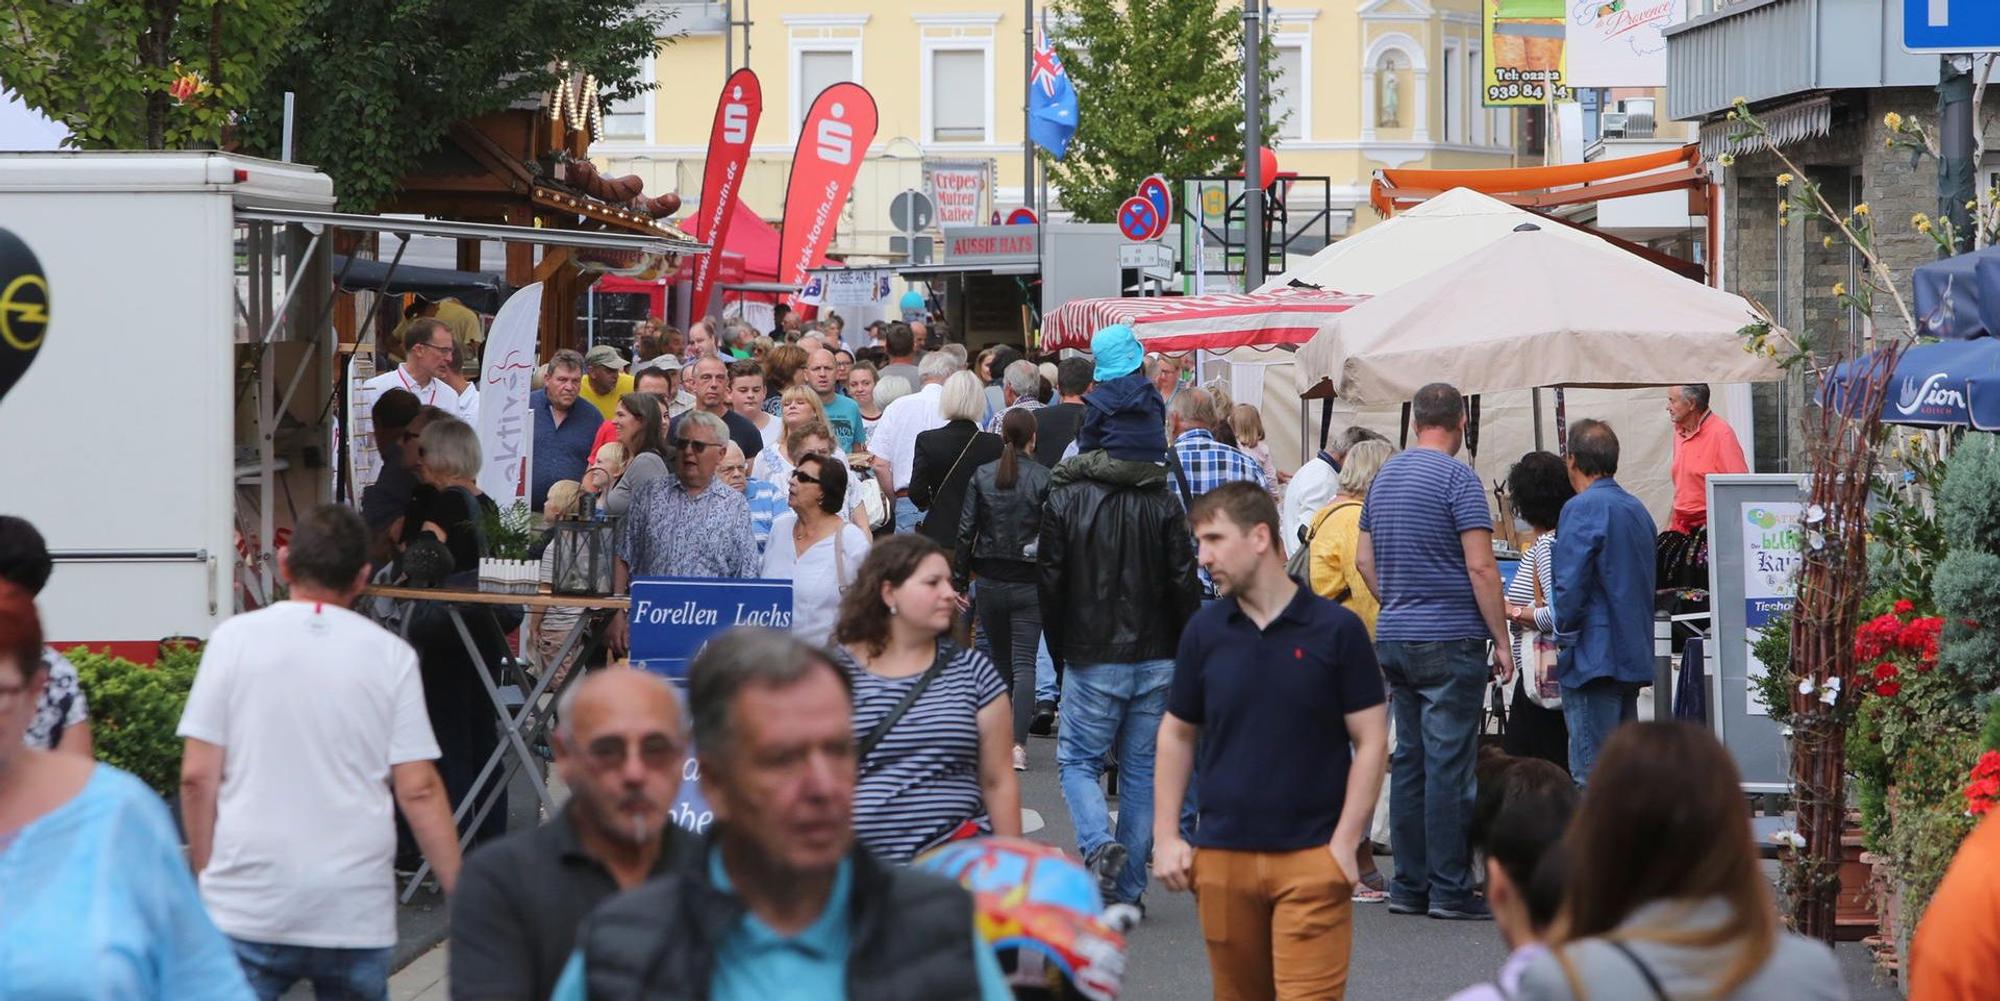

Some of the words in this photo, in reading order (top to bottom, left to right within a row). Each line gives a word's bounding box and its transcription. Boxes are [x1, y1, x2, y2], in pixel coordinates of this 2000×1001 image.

[1489, 83, 1518, 99] 938
[1522, 83, 1543, 99] 84
[953, 237, 997, 256] AUSSIE
[1000, 235, 1034, 254] HATS
[1896, 373, 1966, 415] Sion
[633, 600, 718, 625] Forellen
[734, 603, 792, 627] Lachs
